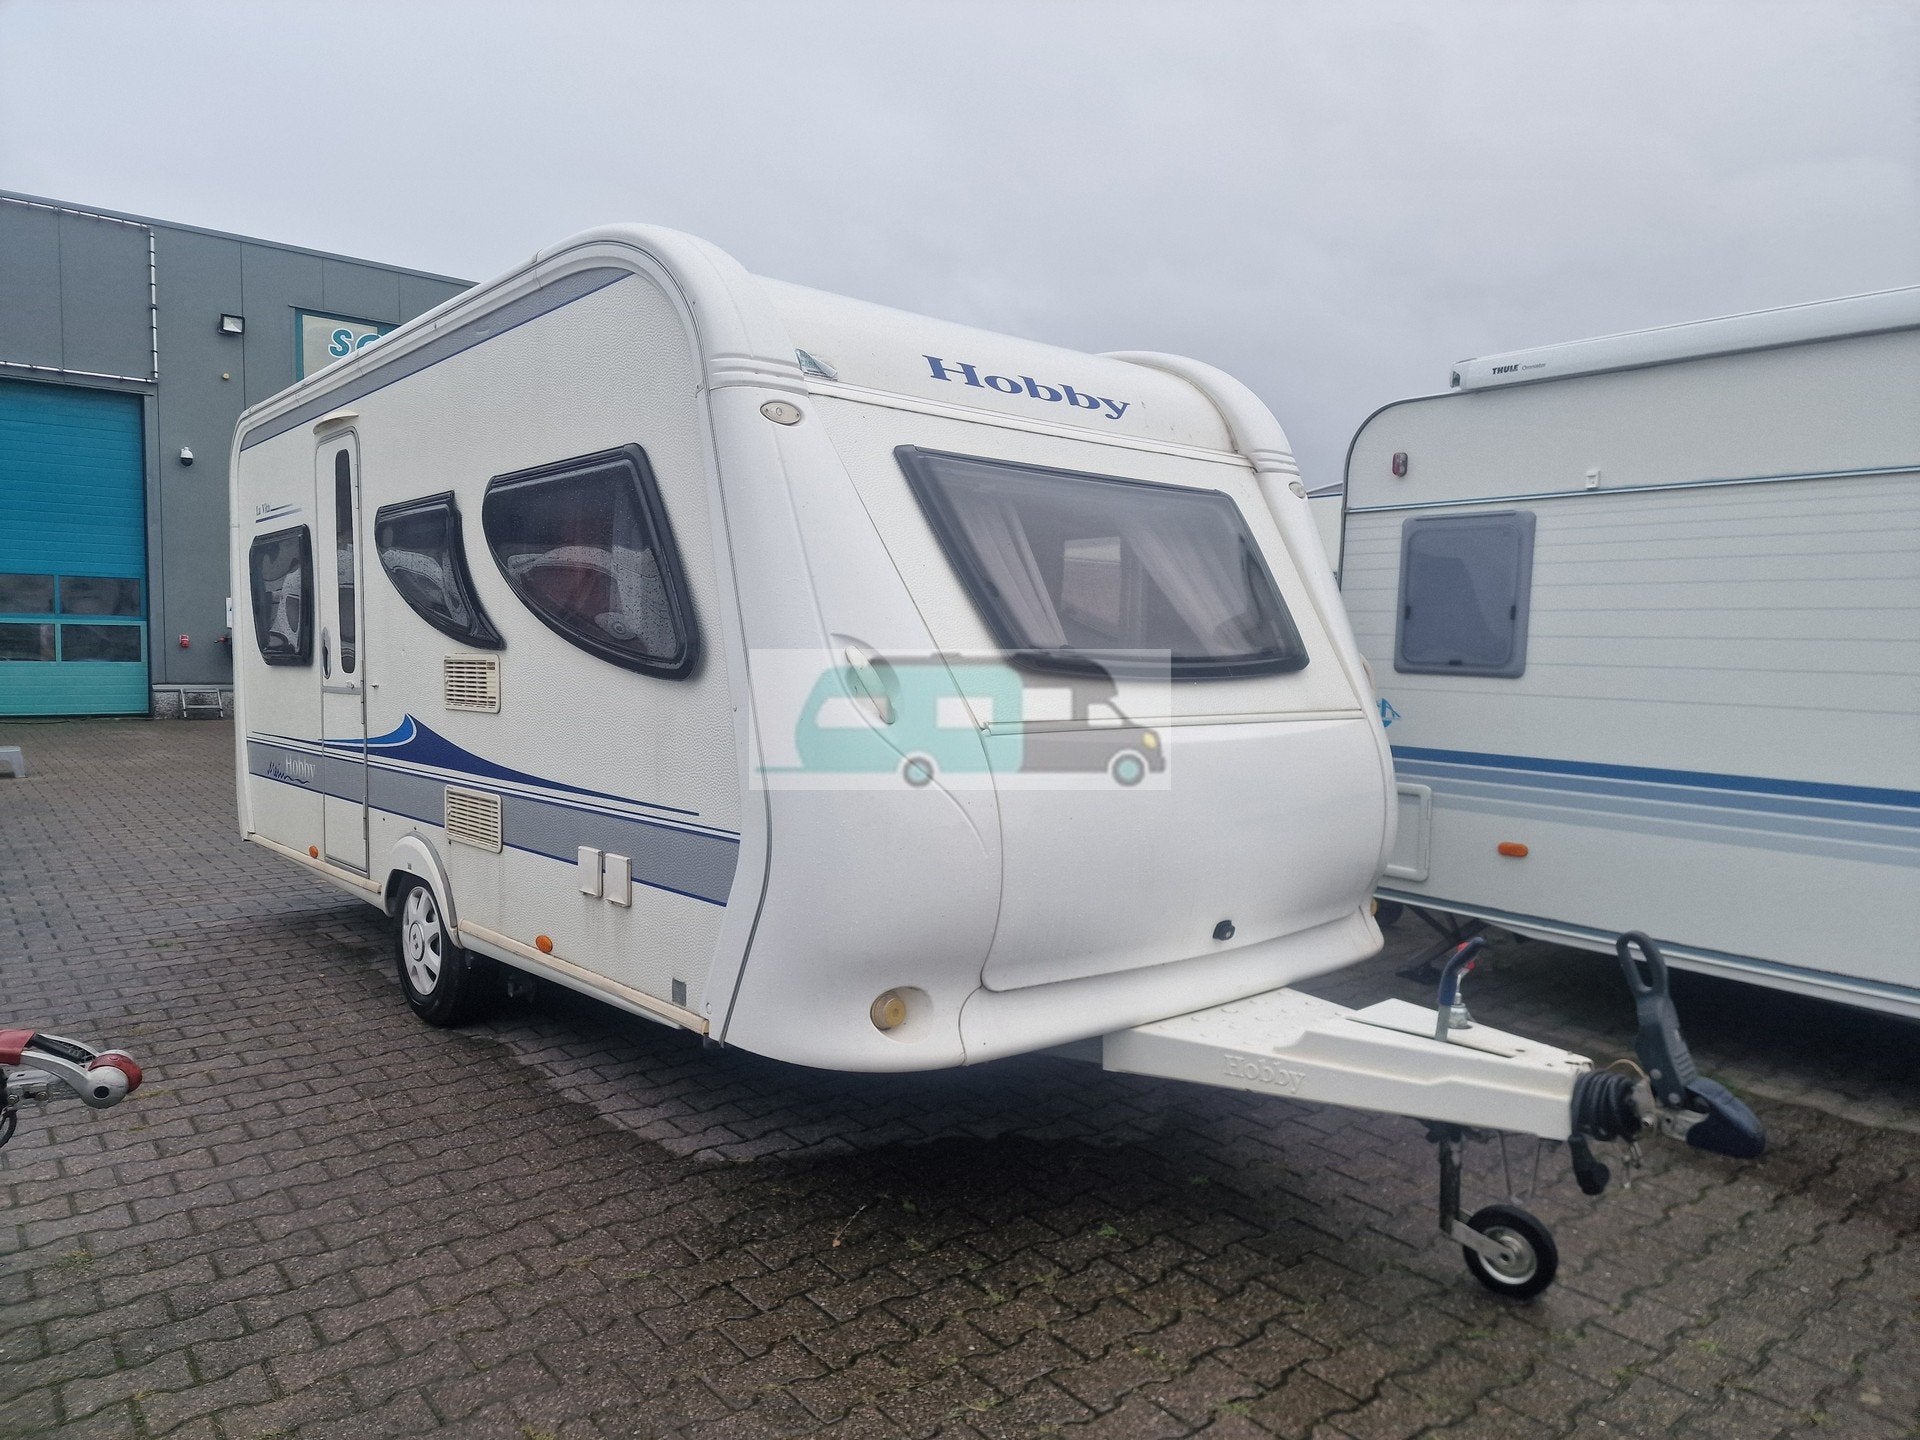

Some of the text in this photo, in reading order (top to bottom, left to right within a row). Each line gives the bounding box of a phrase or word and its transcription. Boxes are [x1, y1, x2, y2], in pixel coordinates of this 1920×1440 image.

[922, 354, 1130, 420] Hobby
[1492, 364, 1519, 374] THULE
[1223, 1055, 1306, 1094] Hobby
